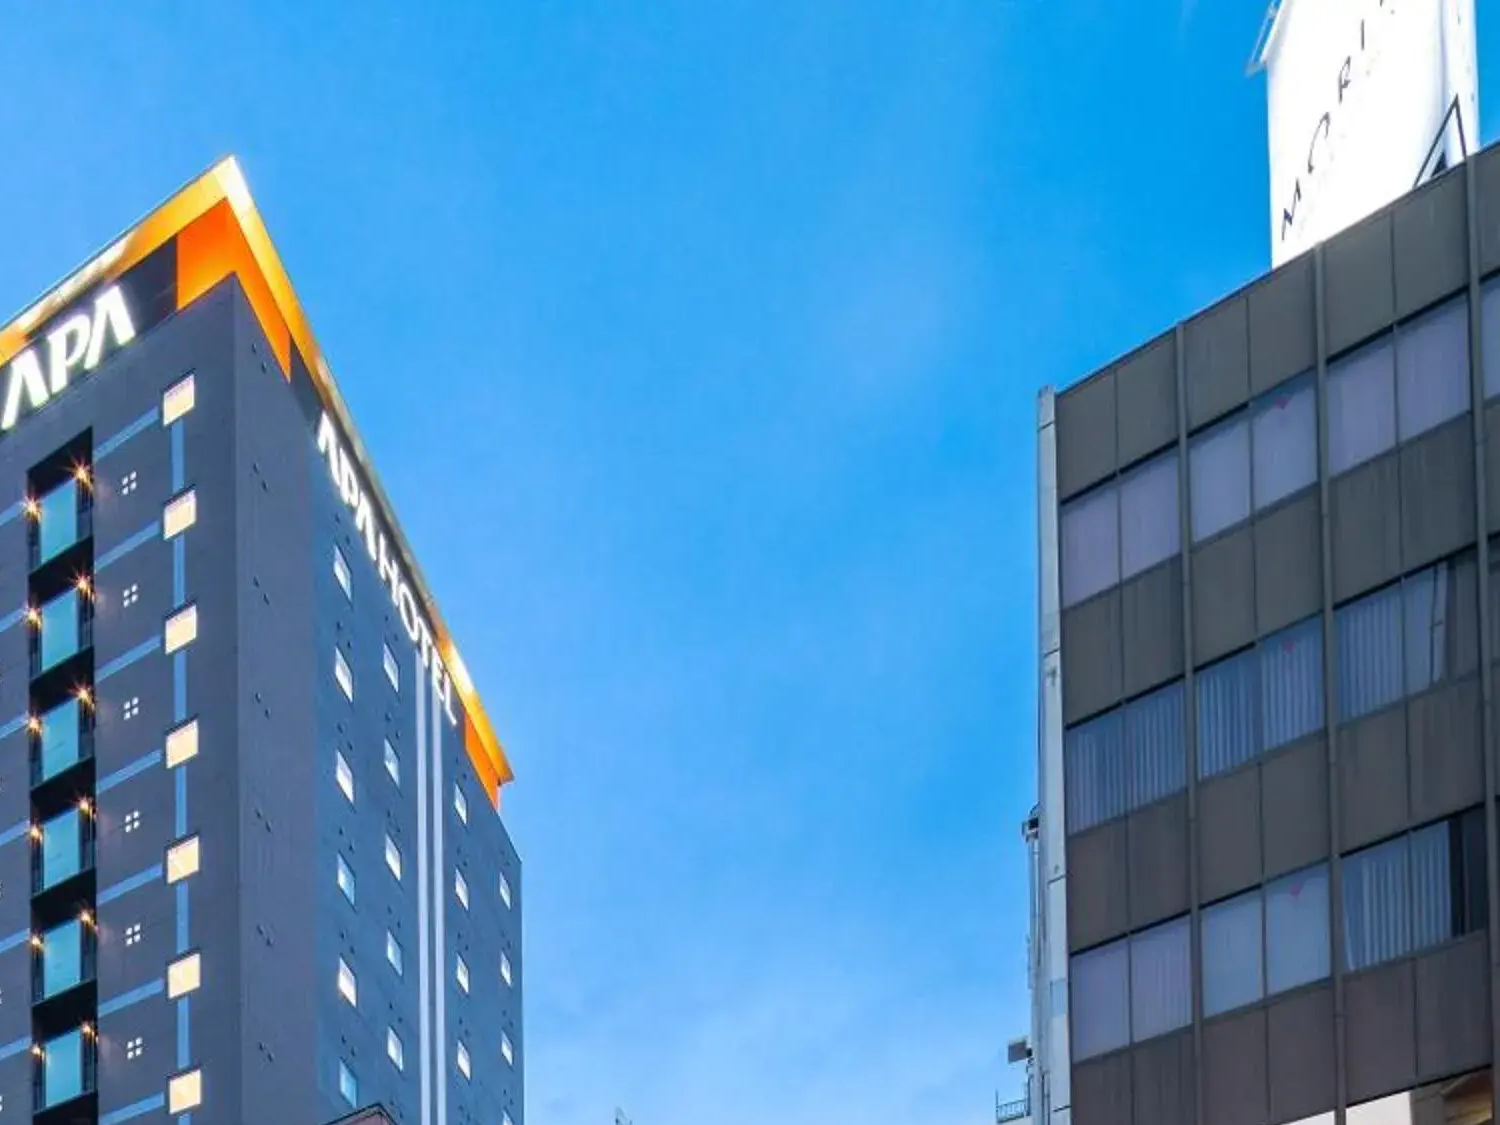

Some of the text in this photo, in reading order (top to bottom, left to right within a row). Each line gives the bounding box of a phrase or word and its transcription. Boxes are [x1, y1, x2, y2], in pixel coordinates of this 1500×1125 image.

[1, 284, 136, 430] APA
[317, 410, 457, 726] APA HOTEL
